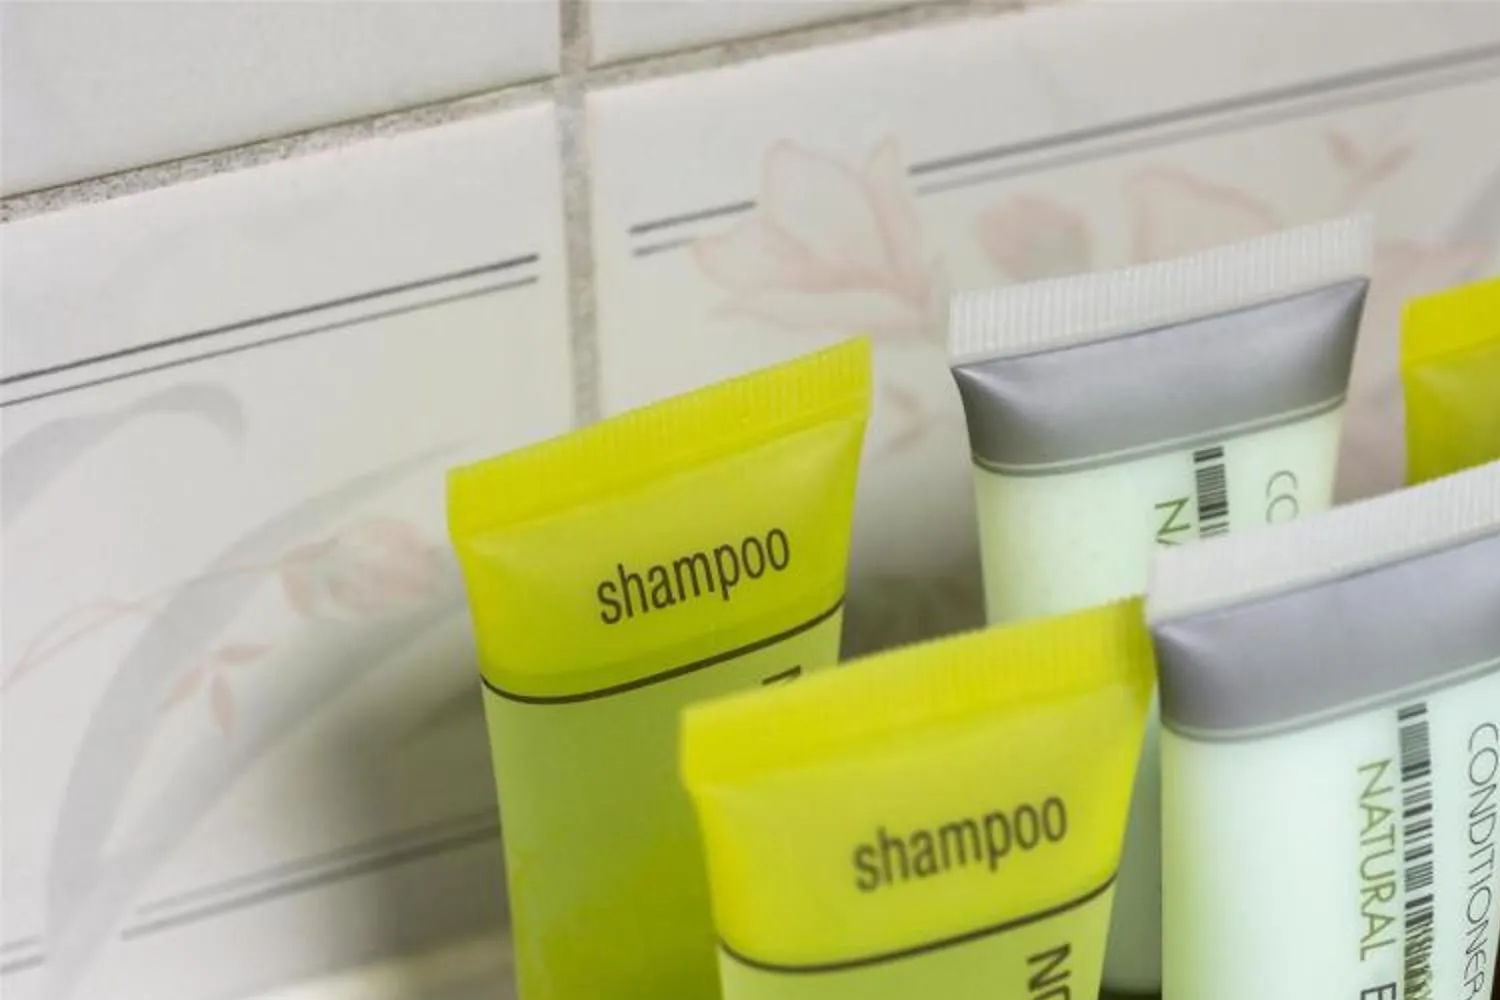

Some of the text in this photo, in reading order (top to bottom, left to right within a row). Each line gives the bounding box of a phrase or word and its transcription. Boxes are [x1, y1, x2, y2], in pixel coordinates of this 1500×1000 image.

[596, 528, 790, 624] shampoo
[853, 796, 1068, 893] shampoo
[1357, 758, 1396, 962] NATURAL
